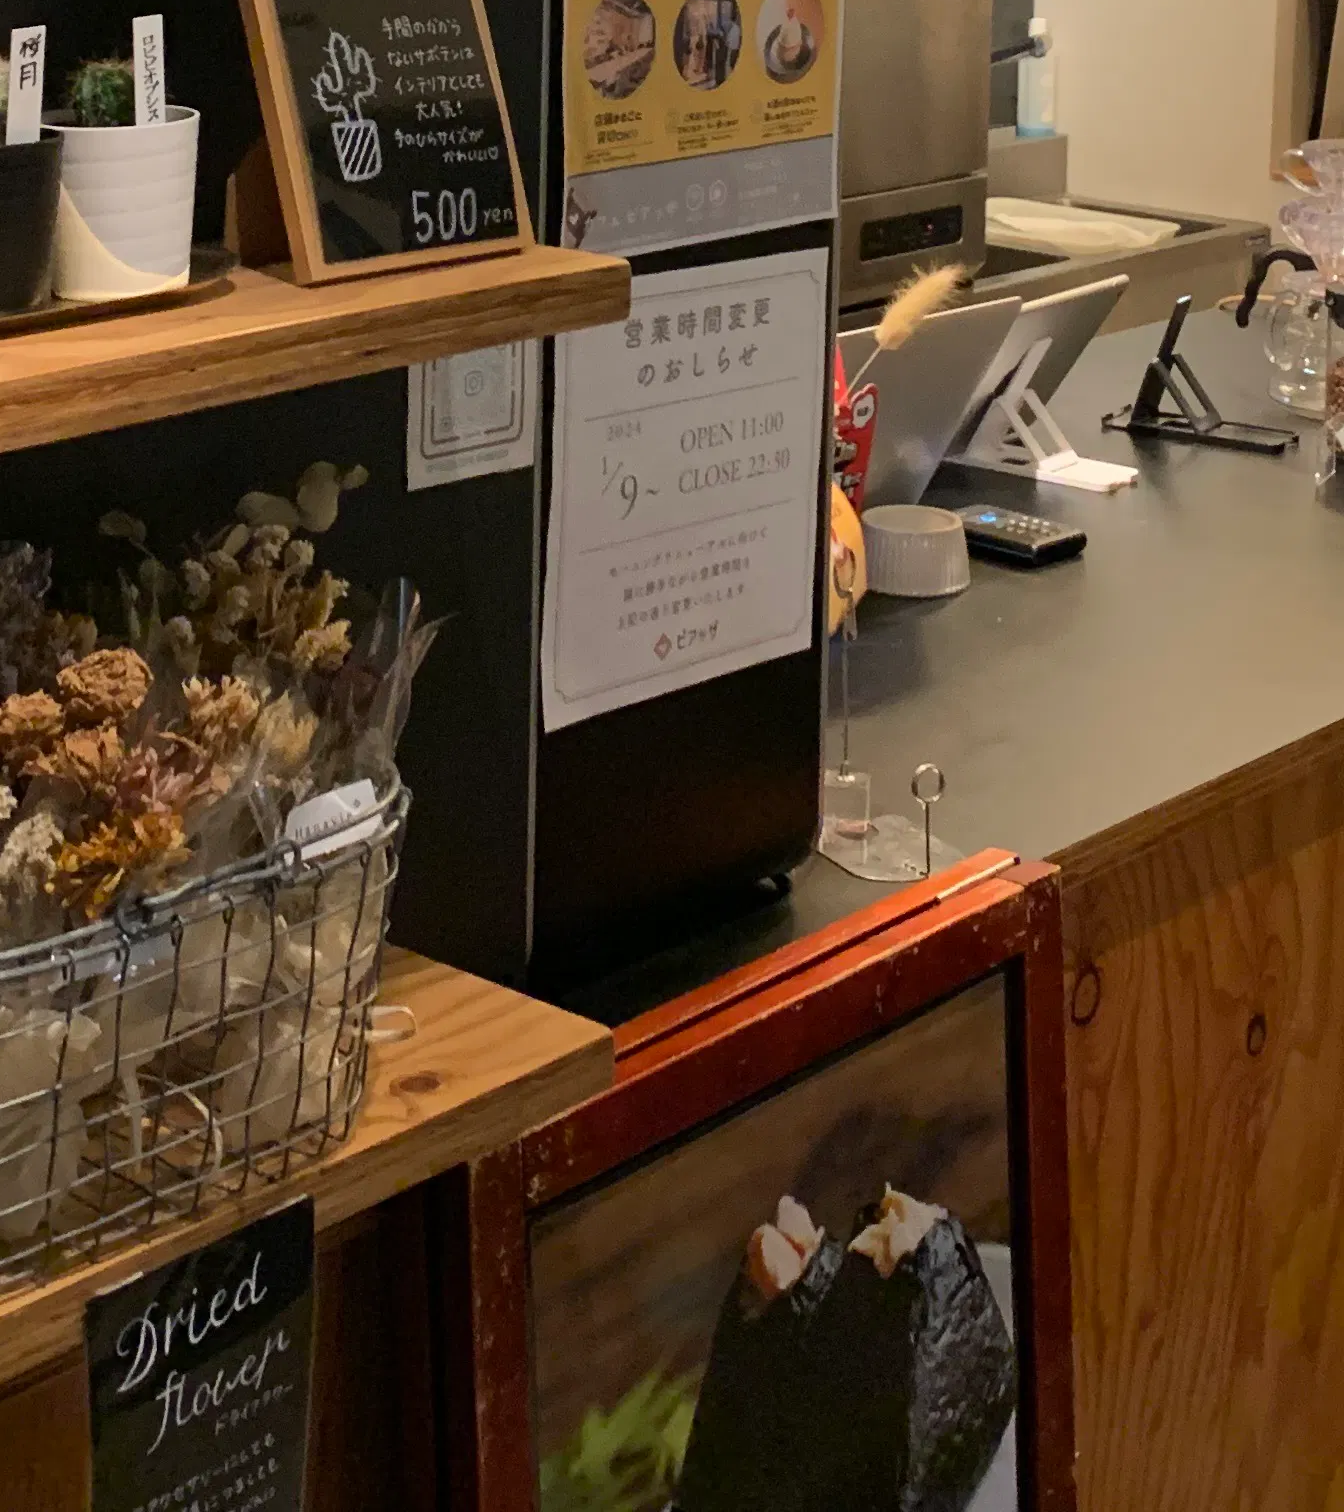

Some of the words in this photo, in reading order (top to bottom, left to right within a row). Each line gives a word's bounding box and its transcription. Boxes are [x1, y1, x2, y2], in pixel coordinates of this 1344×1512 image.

[387, 44, 475, 67] ないサボテンは
[394, 74, 485, 95] インテリアとしても
[394, 126, 484, 149] 手のひらサイズが
[411, 187, 477, 243] 500
[483, 207, 514, 226] yen
[624, 297, 771, 349] 営業時間変更
[637, 343, 759, 387] のおしらせ
[679, 419, 734, 454] OPEN
[741, 411, 784, 440] 11:00
[678, 458, 742, 495] CLOSE
[116, 1251, 268, 1393] Dried
[147, 1328, 291, 1456] flower
